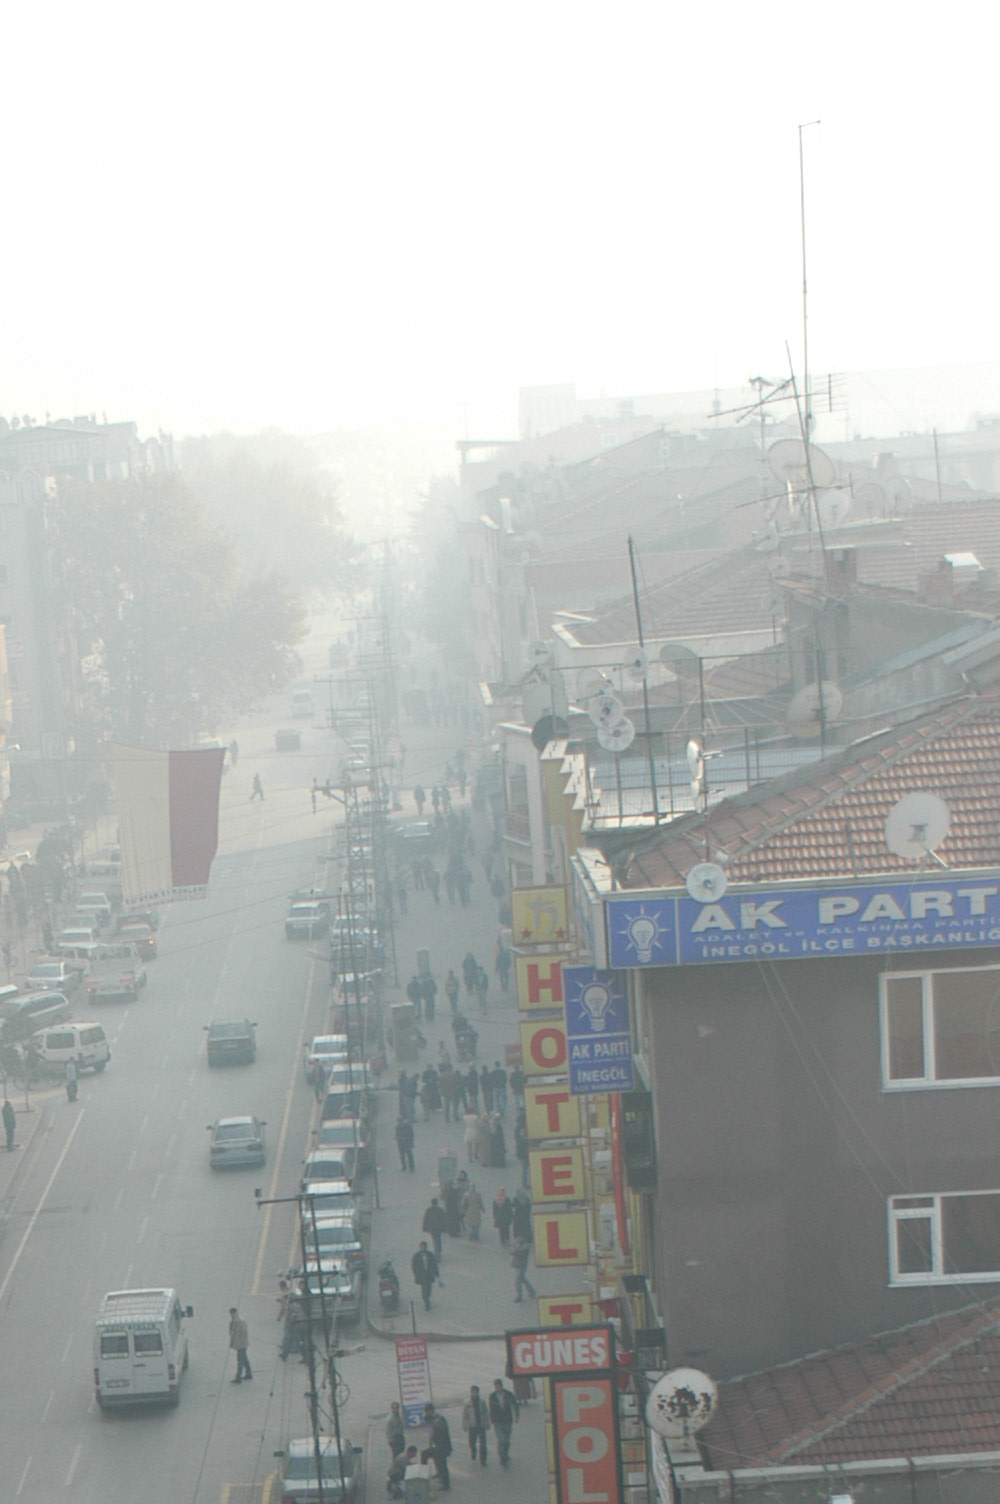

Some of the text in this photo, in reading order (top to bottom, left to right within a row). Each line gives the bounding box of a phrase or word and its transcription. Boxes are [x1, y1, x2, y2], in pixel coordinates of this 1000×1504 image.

[690, 899, 788, 933] AK
[702, 941, 790, 959] İNEGÖL
[801, 937, 855, 952] İLÇE
[572, 1039, 630, 1059] AK PARTİ
[577, 1067, 628, 1084] İNEGÖL
[526, 963, 579, 1260] HOTEL
[515, 1335, 607, 1370] GÜNEŞ
